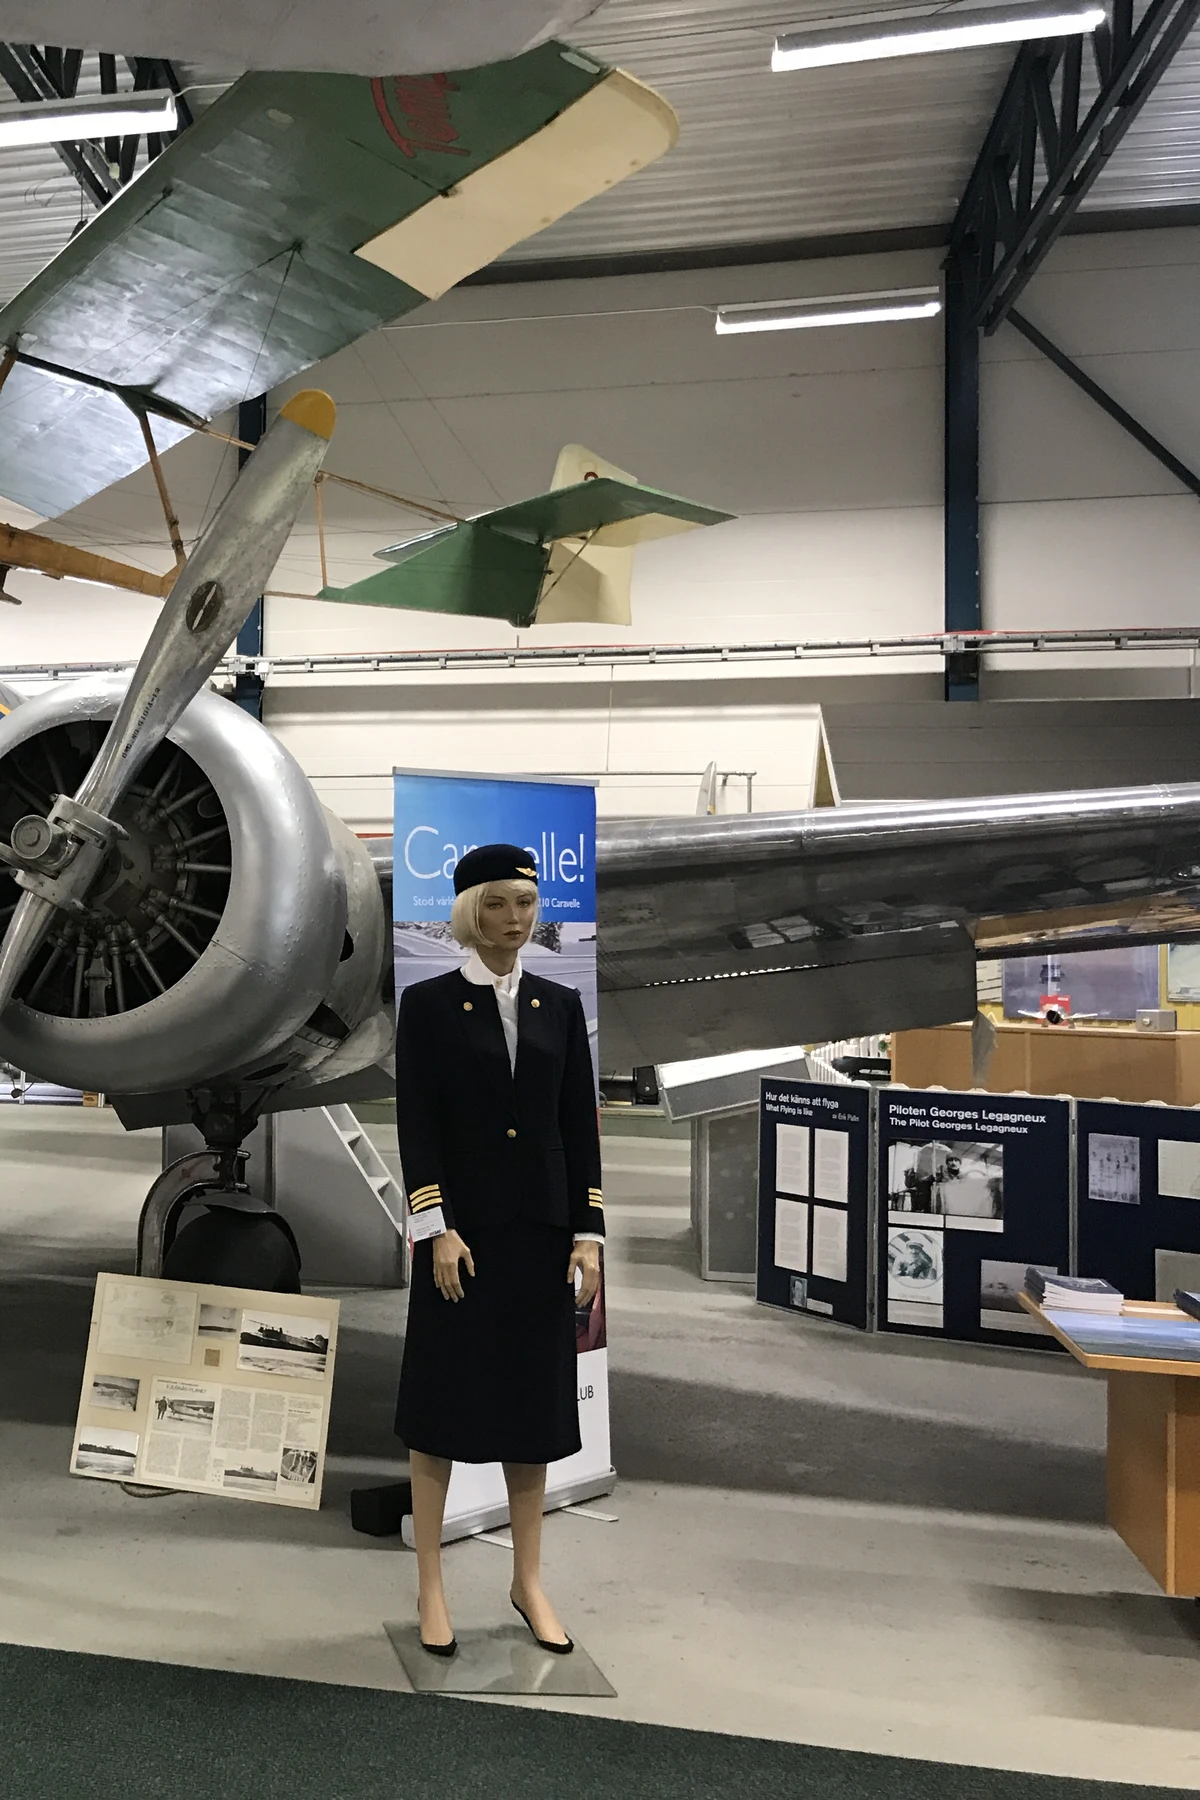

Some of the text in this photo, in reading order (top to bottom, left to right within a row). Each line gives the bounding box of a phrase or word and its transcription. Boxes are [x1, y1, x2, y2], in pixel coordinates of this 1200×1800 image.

[551, 897, 580, 909] Caravelle
[765, 1091, 777, 1101] Hur
[779, 1093, 789, 1103] det
[811, 1096, 821, 1107] att
[822, 1097, 839, 1110] flyga
[765, 1103, 779, 1112] What
[780, 1105, 796, 1115] Flying
[889, 1104, 1047, 1124] Piloten Georges Legagneux
[889, 1117, 1028, 1134] The Pilot Georges Legagneux
[577, 1385, 594, 1401] UB
